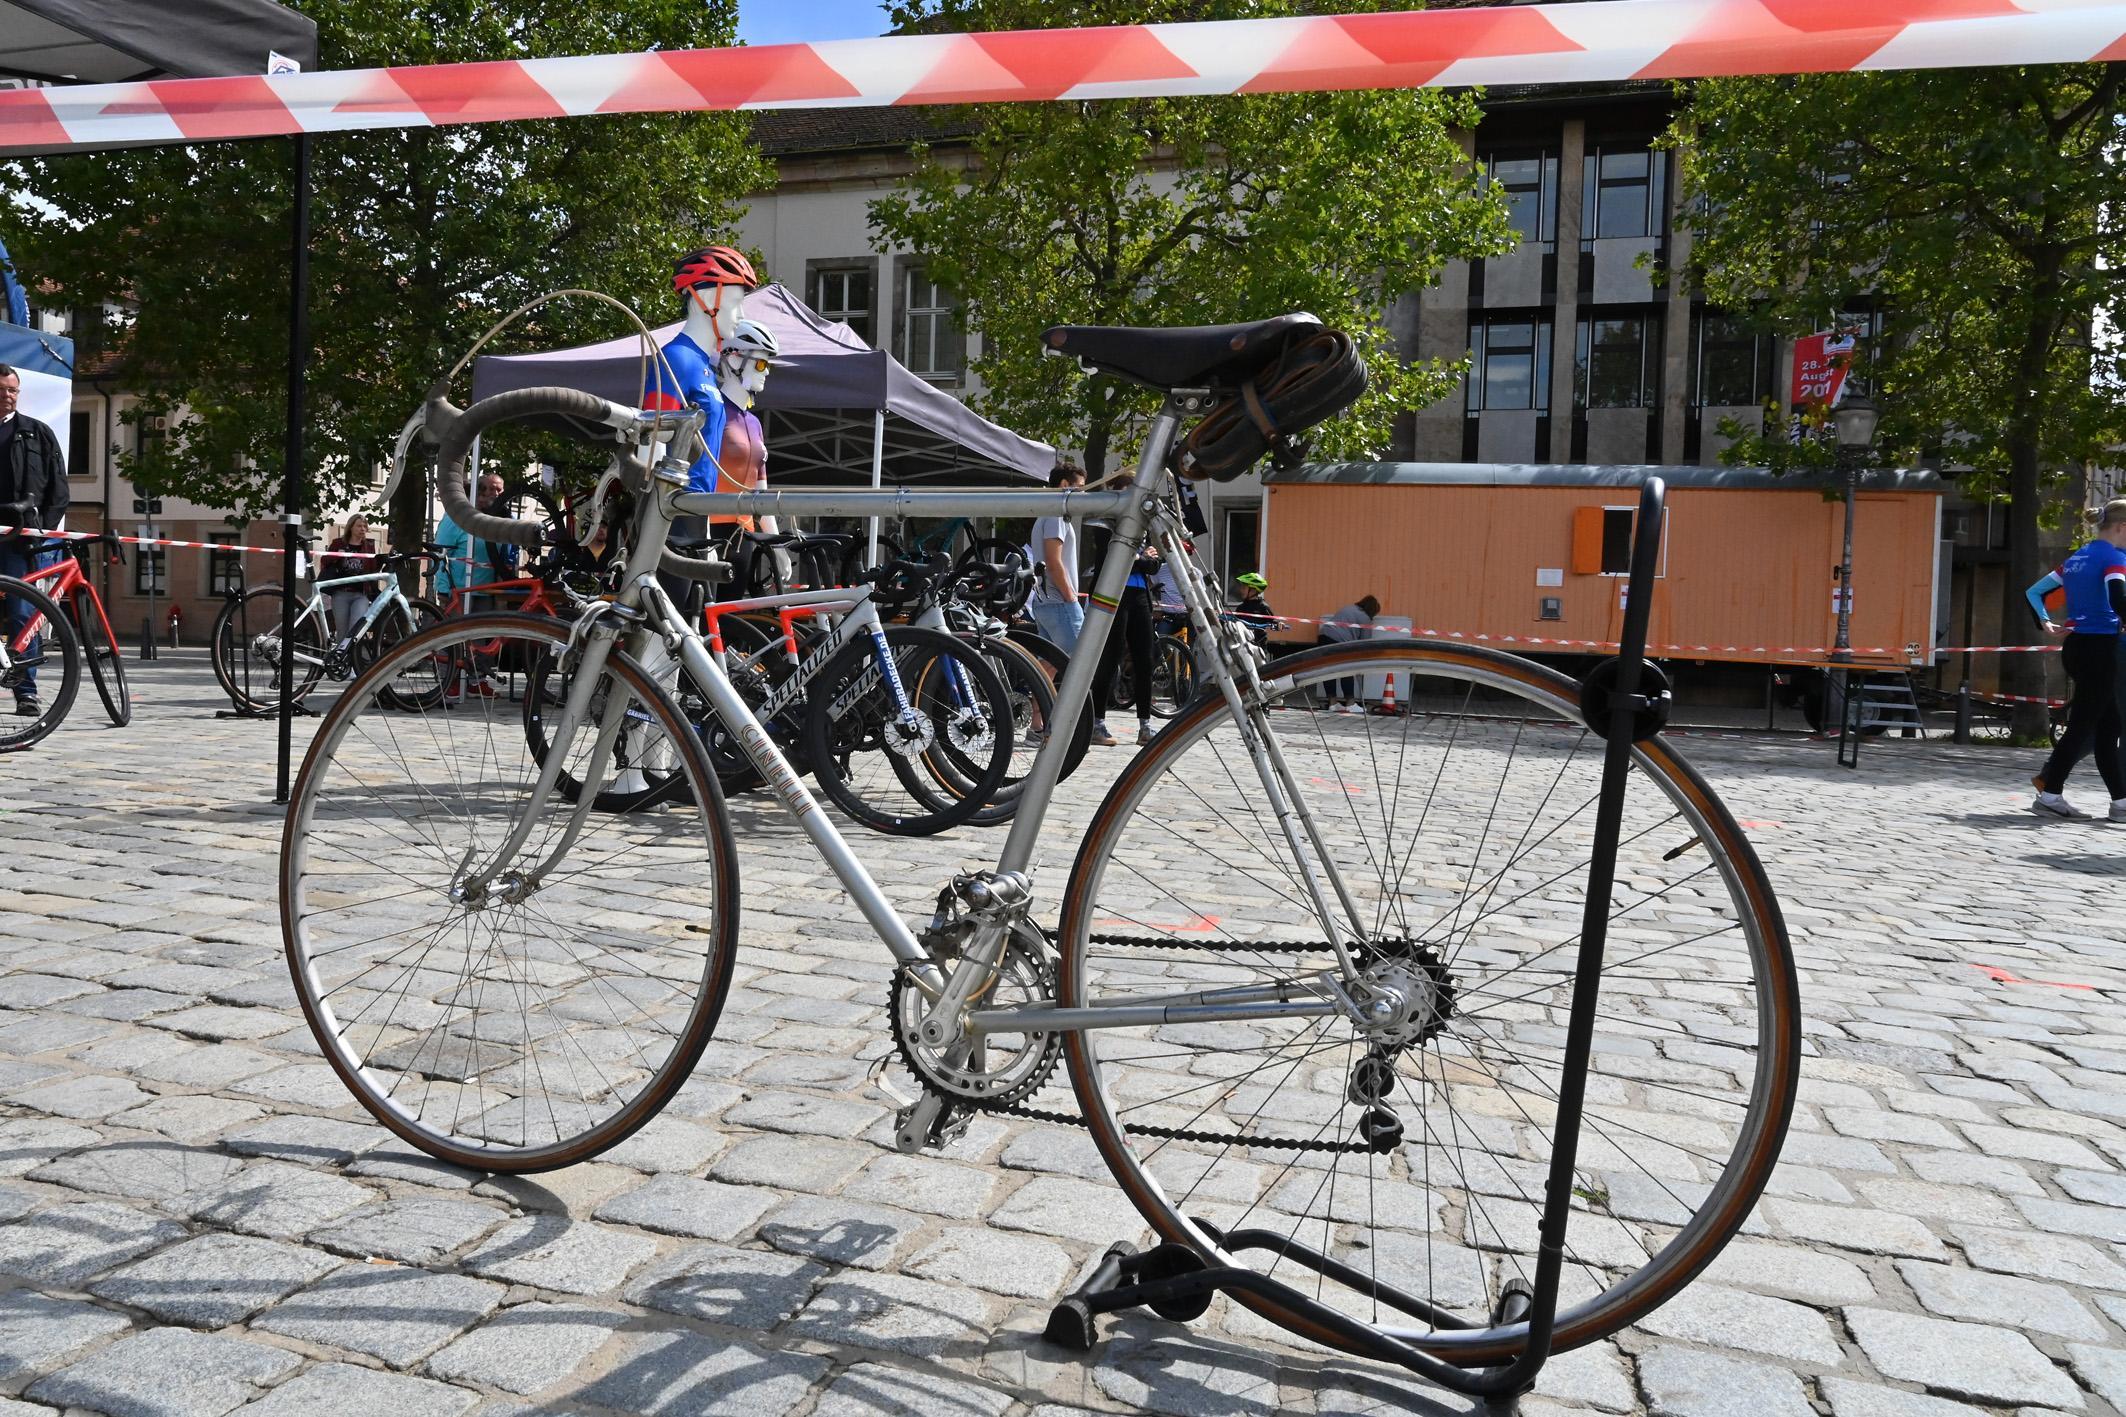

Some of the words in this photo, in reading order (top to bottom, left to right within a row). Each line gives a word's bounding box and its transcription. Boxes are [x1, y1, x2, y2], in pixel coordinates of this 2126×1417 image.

[763, 628, 843, 715] SPECIALIZED
[877, 636, 913, 720] FAHRRADECKE.DE
[741, 724, 813, 816] CINELLI
